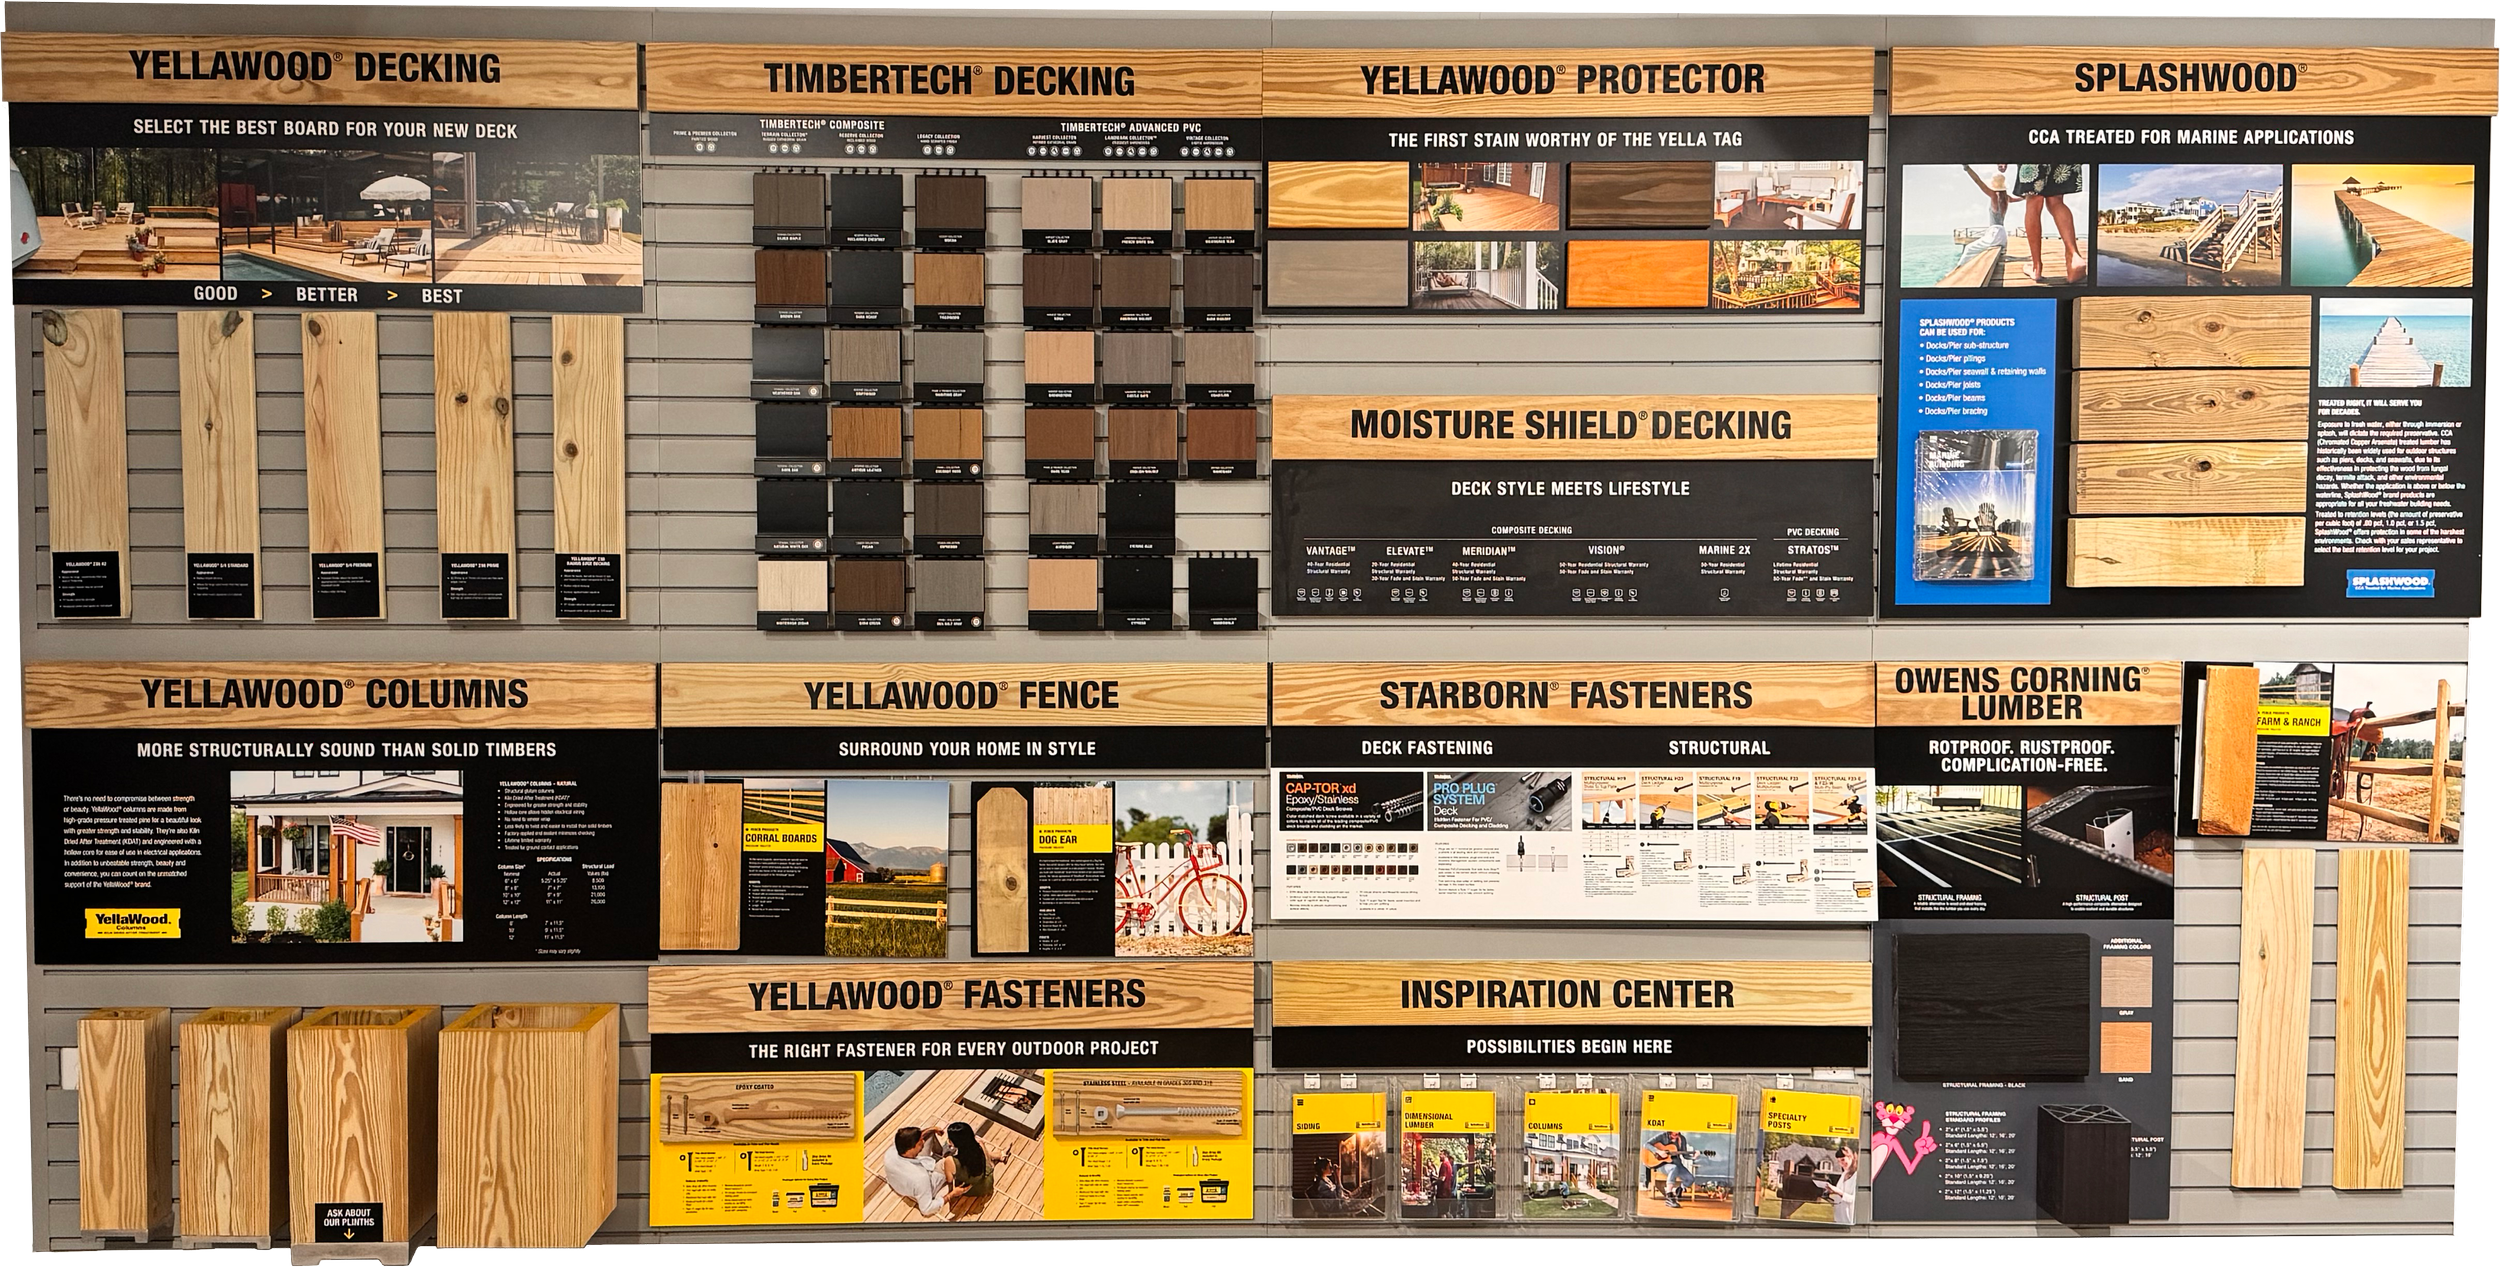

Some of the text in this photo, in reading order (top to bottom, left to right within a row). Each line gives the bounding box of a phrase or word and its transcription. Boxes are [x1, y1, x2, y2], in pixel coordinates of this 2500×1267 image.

[355, 52, 500, 83] DECKING
[994, 66, 1134, 96] DECKING
[1578, 63, 1764, 94] PROTECTOR
[133, 119, 518, 139] SELECT THE BEST BOARD FOR YOUR NEW DECK
[829, 120, 885, 130] COMPOSITE
[1129, 123, 1179, 132] ADVANCED
[1183, 123, 1201, 133] PVC
[1388, 131, 1742, 148] THE FIRST STAIN WORTHY OF THE YELLA TAG
[2028, 129, 2354, 145] CCA TREATED FOR MARINE APPLICATIONS
[194, 285, 238, 301] GOOD
[296, 287, 358, 302] BETTER
[422, 288, 463, 304] BEST
[1962, 380, 1981, 391] joists
[1962, 407, 1988, 417] bracing
[1352, 410, 1514, 439] MOISTURE
[1652, 410, 1791, 440] DECKING
[1452, 481, 1690, 496] DECK STYLE MEETS LIFESTYLE
[1738, 545, 1751, 555] 2X
[1896, 667, 1999, 693] OWENS
[366, 679, 528, 708] COLUMNS
[1020, 680, 1119, 709] FENCE
[1571, 681, 1752, 709] FASTENERS
[1962, 694, 2082, 720] LUMBER
[2257, 717, 2281, 726] FARM
[137, 742, 556, 757] MORE STRUCTURALLY SOUND THAN SOLID TIMBERS
[839, 741, 1096, 756] SURROUND YOUR HOME IN STYLE
[1362, 740, 1493, 755] DECK FASTENING
[1669, 740, 1771, 755] STRUCTURAL
[1929, 740, 2115, 755] ROTPROOF. RUSTPROOF.
[1941, 757, 2108, 772] COMPLICATION-FREE.
[1433, 782, 1460, 794] PRO
[1286, 794, 1359, 806] Epoxy/Stainless
[1433, 794, 1486, 805] SYSTEM
[1433, 805, 1459, 816] Deck
[965, 979, 1145, 1009] FASTENERS
[1402, 980, 1734, 1008] INSPIRATION CENTER
[748, 1040, 1159, 1059] THE RIGHT FASTENER FOR EVERY OUTDOOR PROJECT
[1467, 1039, 1672, 1054] POSSIBILITIES BEGIN HERE
[1768, 1111, 1807, 1122] SPECIALTY
